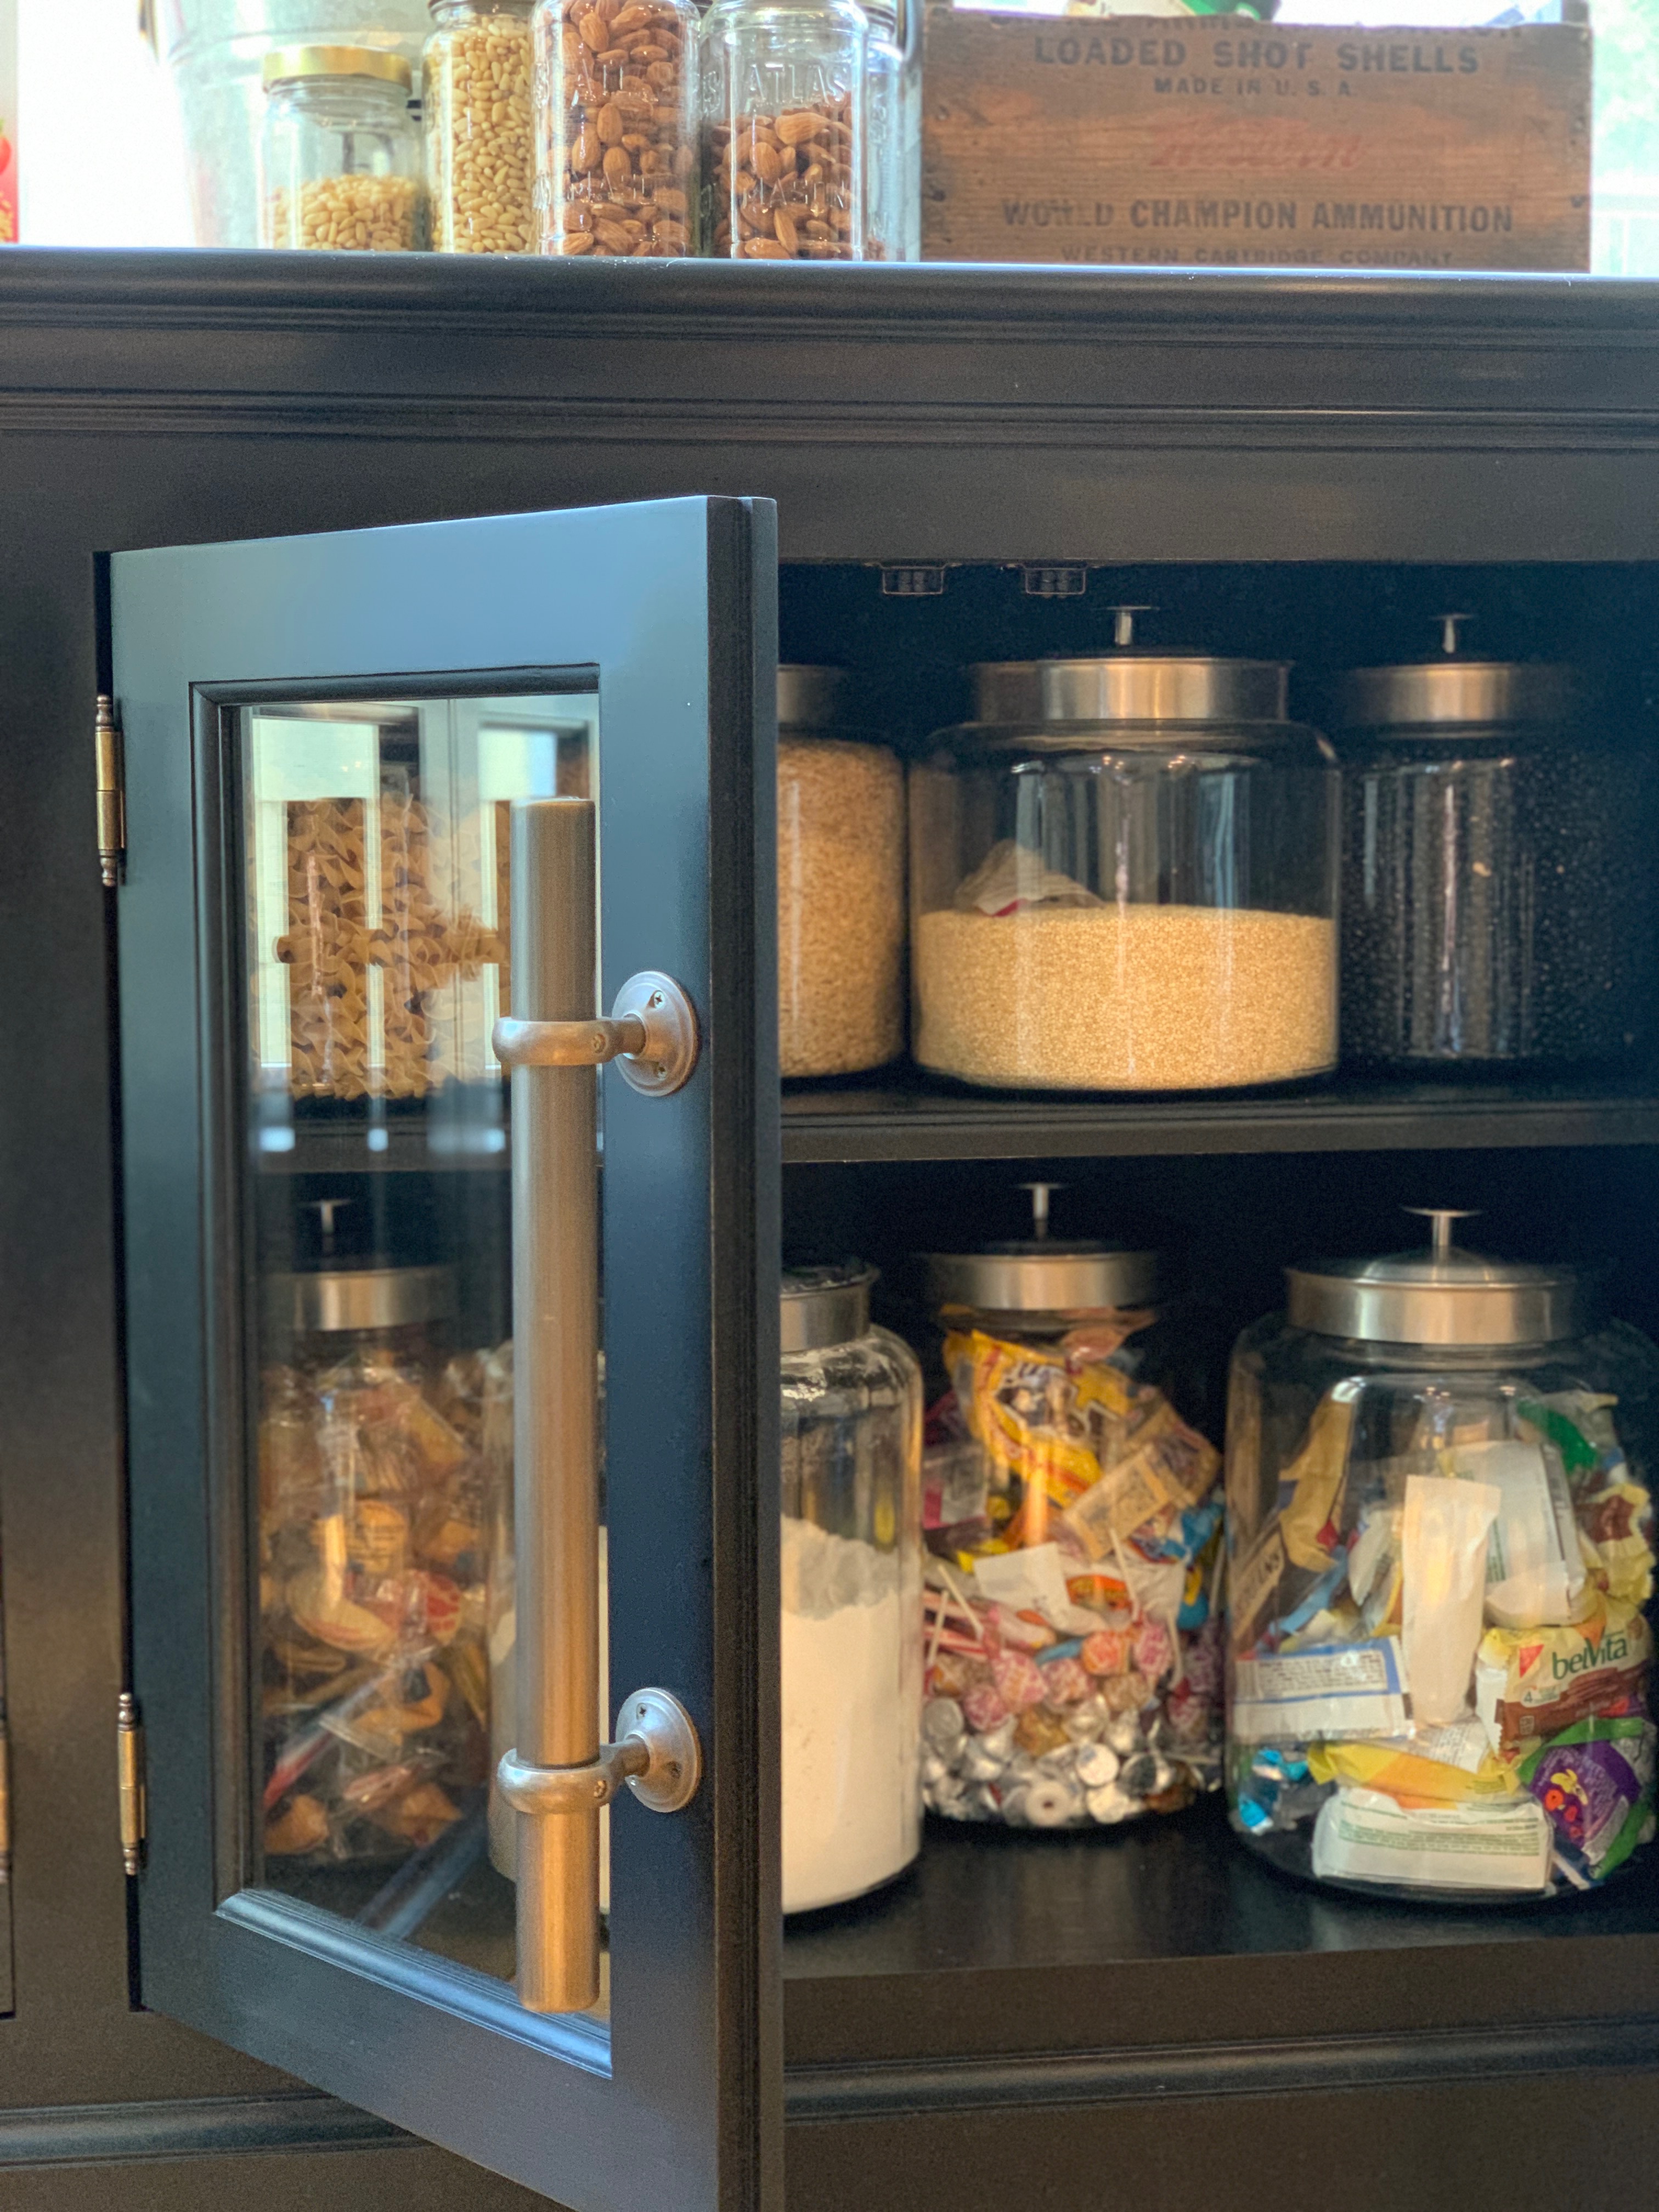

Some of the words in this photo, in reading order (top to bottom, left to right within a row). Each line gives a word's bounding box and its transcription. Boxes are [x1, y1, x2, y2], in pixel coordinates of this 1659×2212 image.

[1034, 36, 1187, 65] LOADED
[1213, 40, 1312, 70] SHOT
[1337, 43, 1479, 73] SHELLS
[743, 61, 848, 110] ATLAS
[1154, 77, 1223, 94] MADE
[1237, 78, 1261, 95] IN
[1130, 200, 1296, 229] CHAMPION
[1314, 203, 1512, 232] AMMUNITION
[1062, 246, 1178, 262] WESTERN
[1195, 248, 1322, 264] CARTRIDGE
[1339, 250, 1453, 266] COMPANY
[1552, 1638, 1628, 1680] belVita
